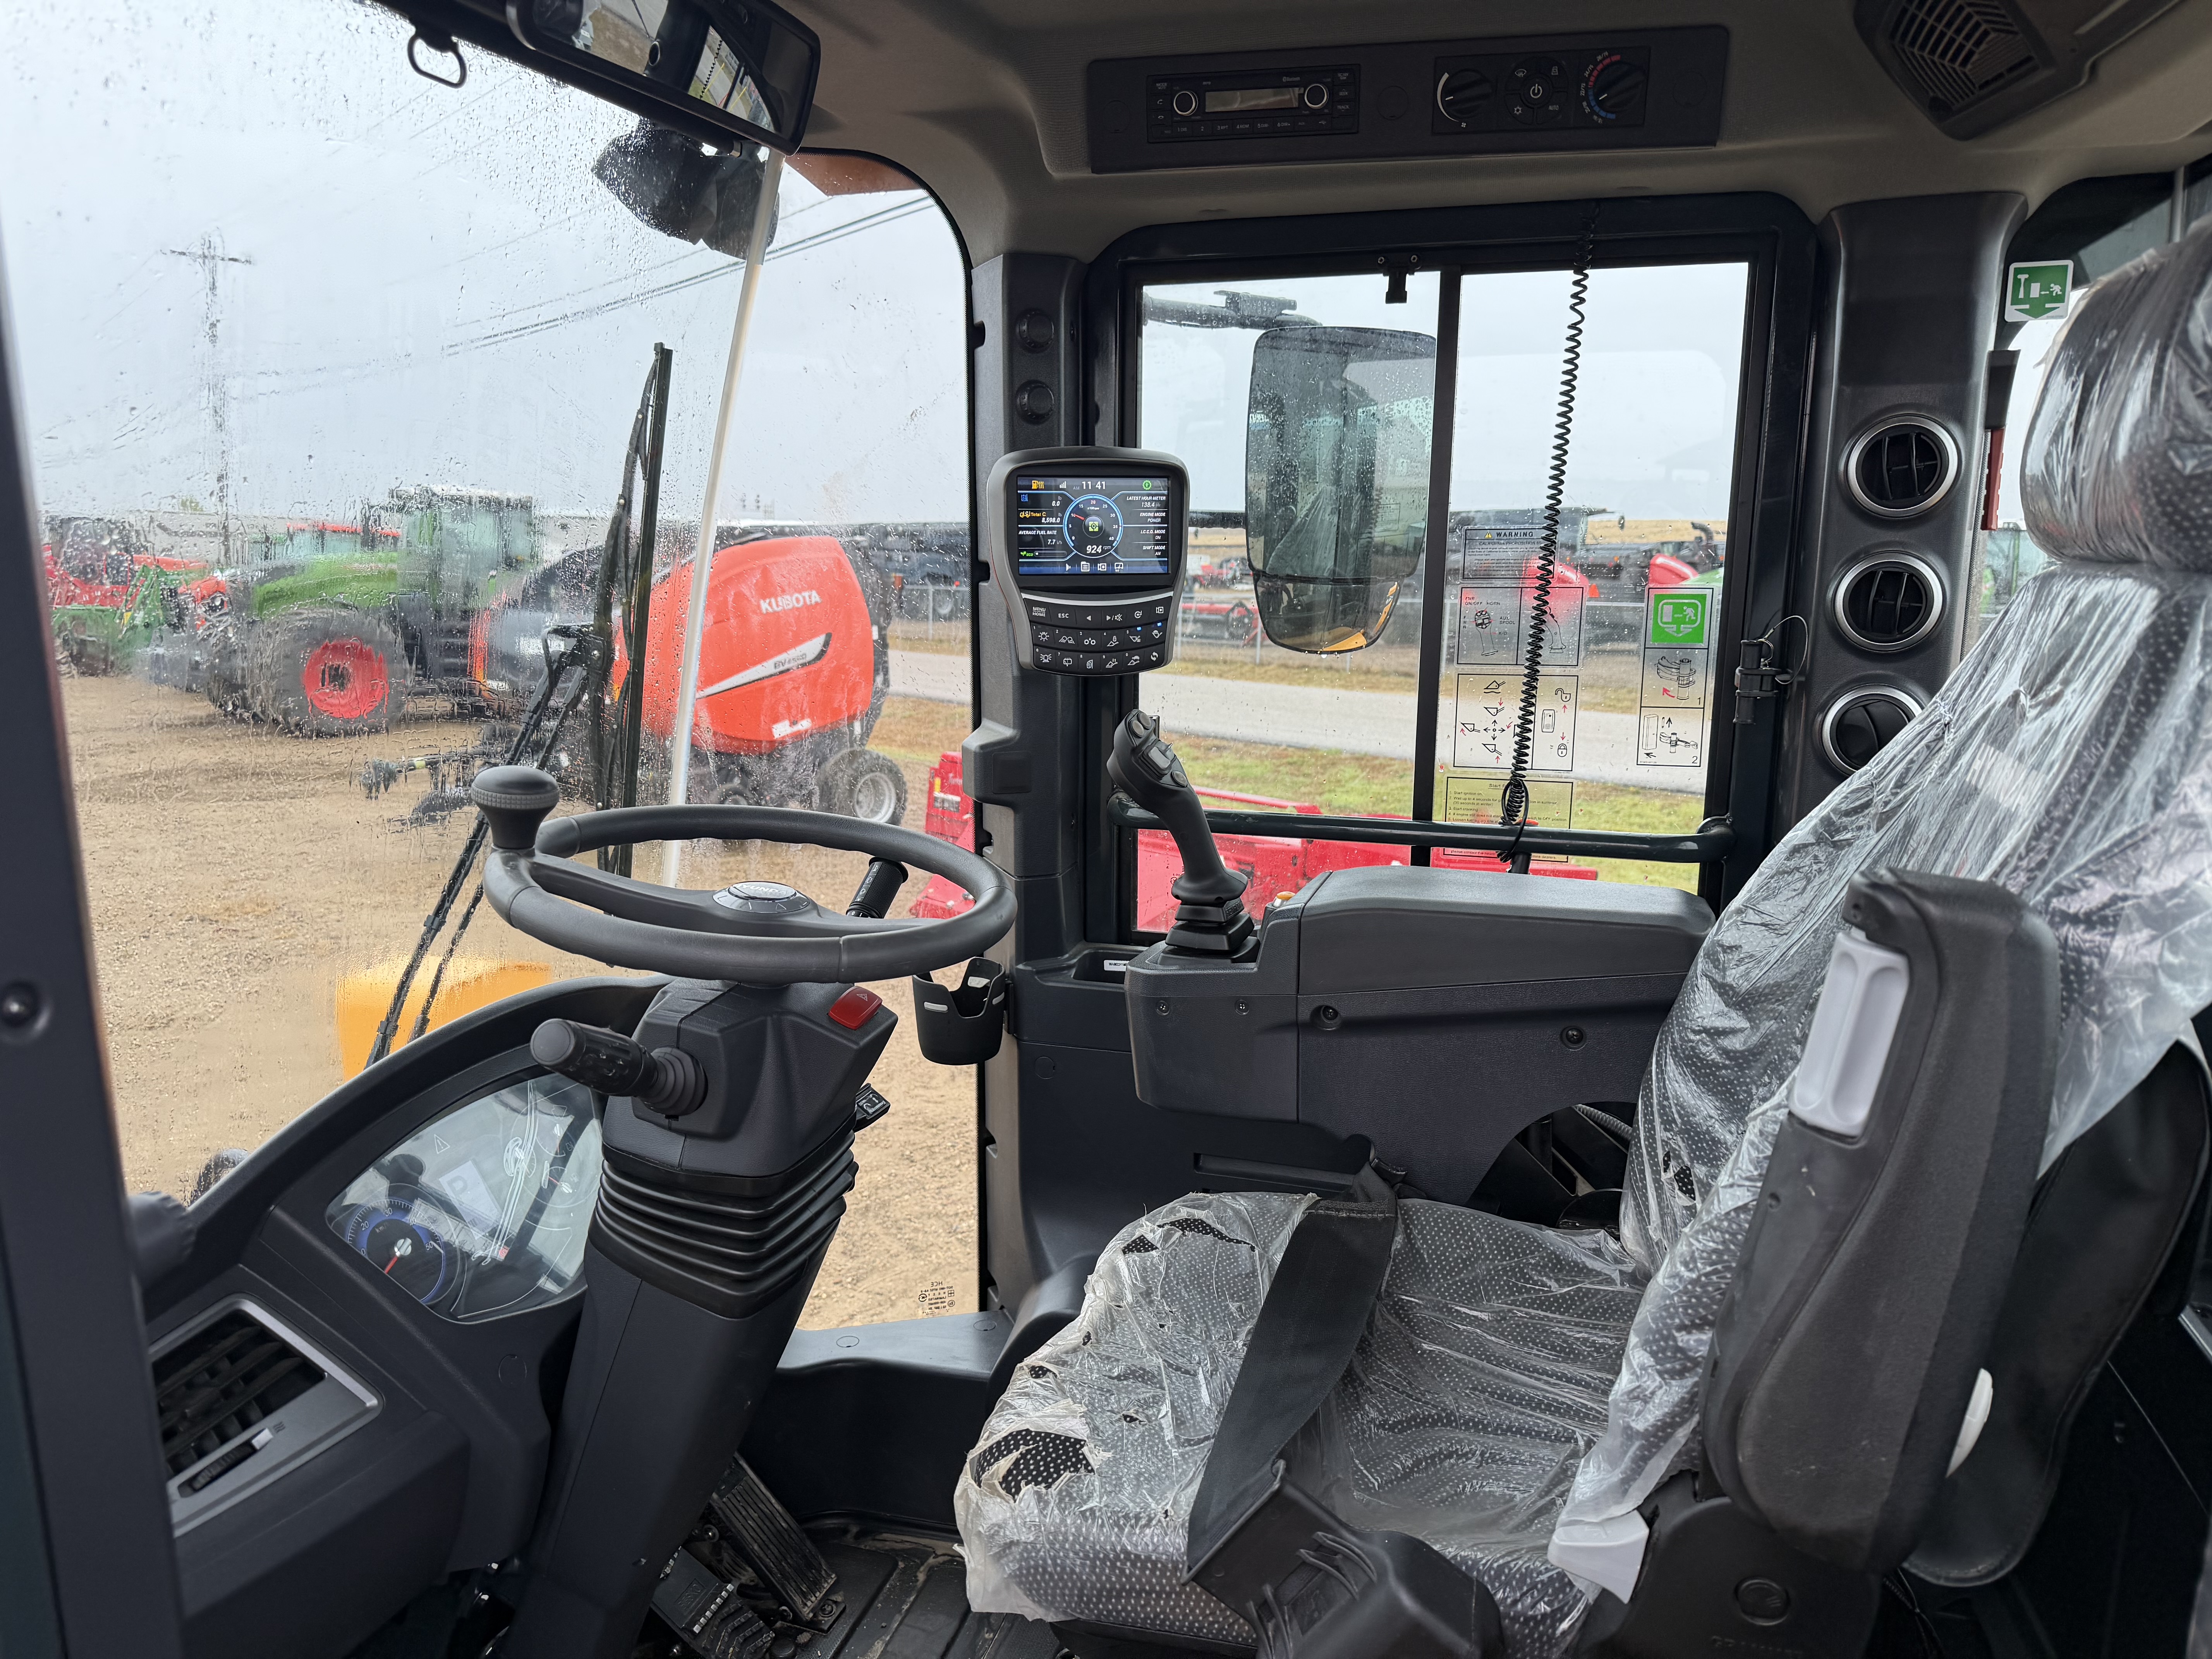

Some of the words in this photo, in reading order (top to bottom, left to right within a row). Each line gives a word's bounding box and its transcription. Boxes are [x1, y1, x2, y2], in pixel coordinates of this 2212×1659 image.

[1087, 545, 1102, 553] 924
[760, 590, 822, 614] KUBOTA
[1697, 697, 1701, 705] 1
[446, 1175, 468, 1197] P
[385, 1207, 393, 1217] 30
[361, 1221, 369, 1231] 20
[409, 1218, 417, 1226] 40
[426, 1241, 433, 1251] 50
